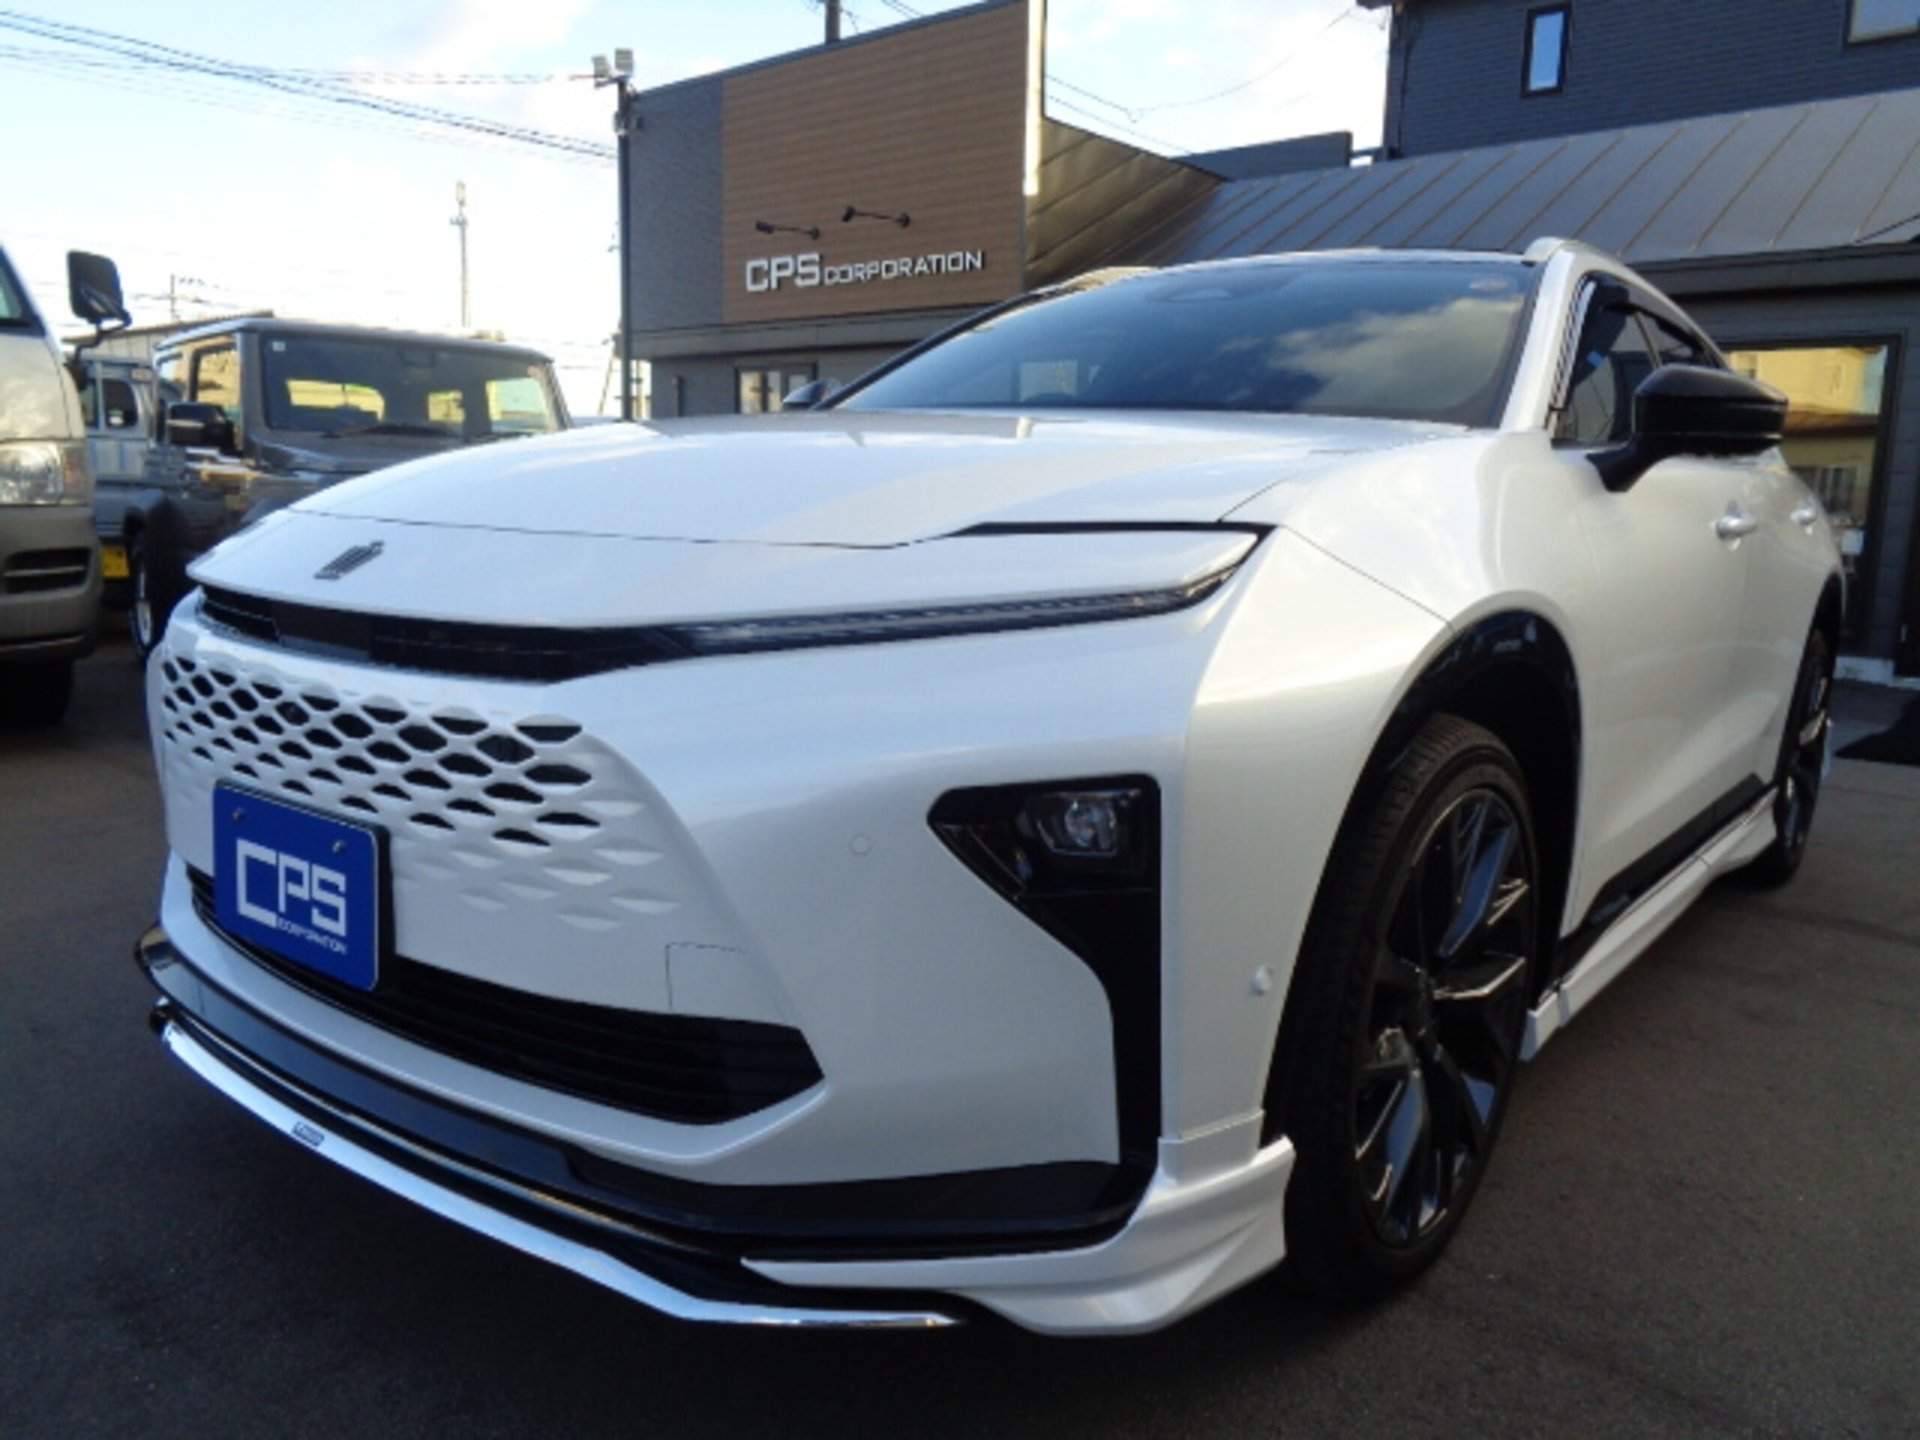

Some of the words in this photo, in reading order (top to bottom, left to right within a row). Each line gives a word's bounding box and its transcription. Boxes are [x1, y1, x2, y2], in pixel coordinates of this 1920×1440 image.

[746, 252, 821, 292] CPS
[824, 250, 983, 286] CORPORATION
[236, 838, 346, 937] CPS
[278, 917, 347, 955] CORPORATION
